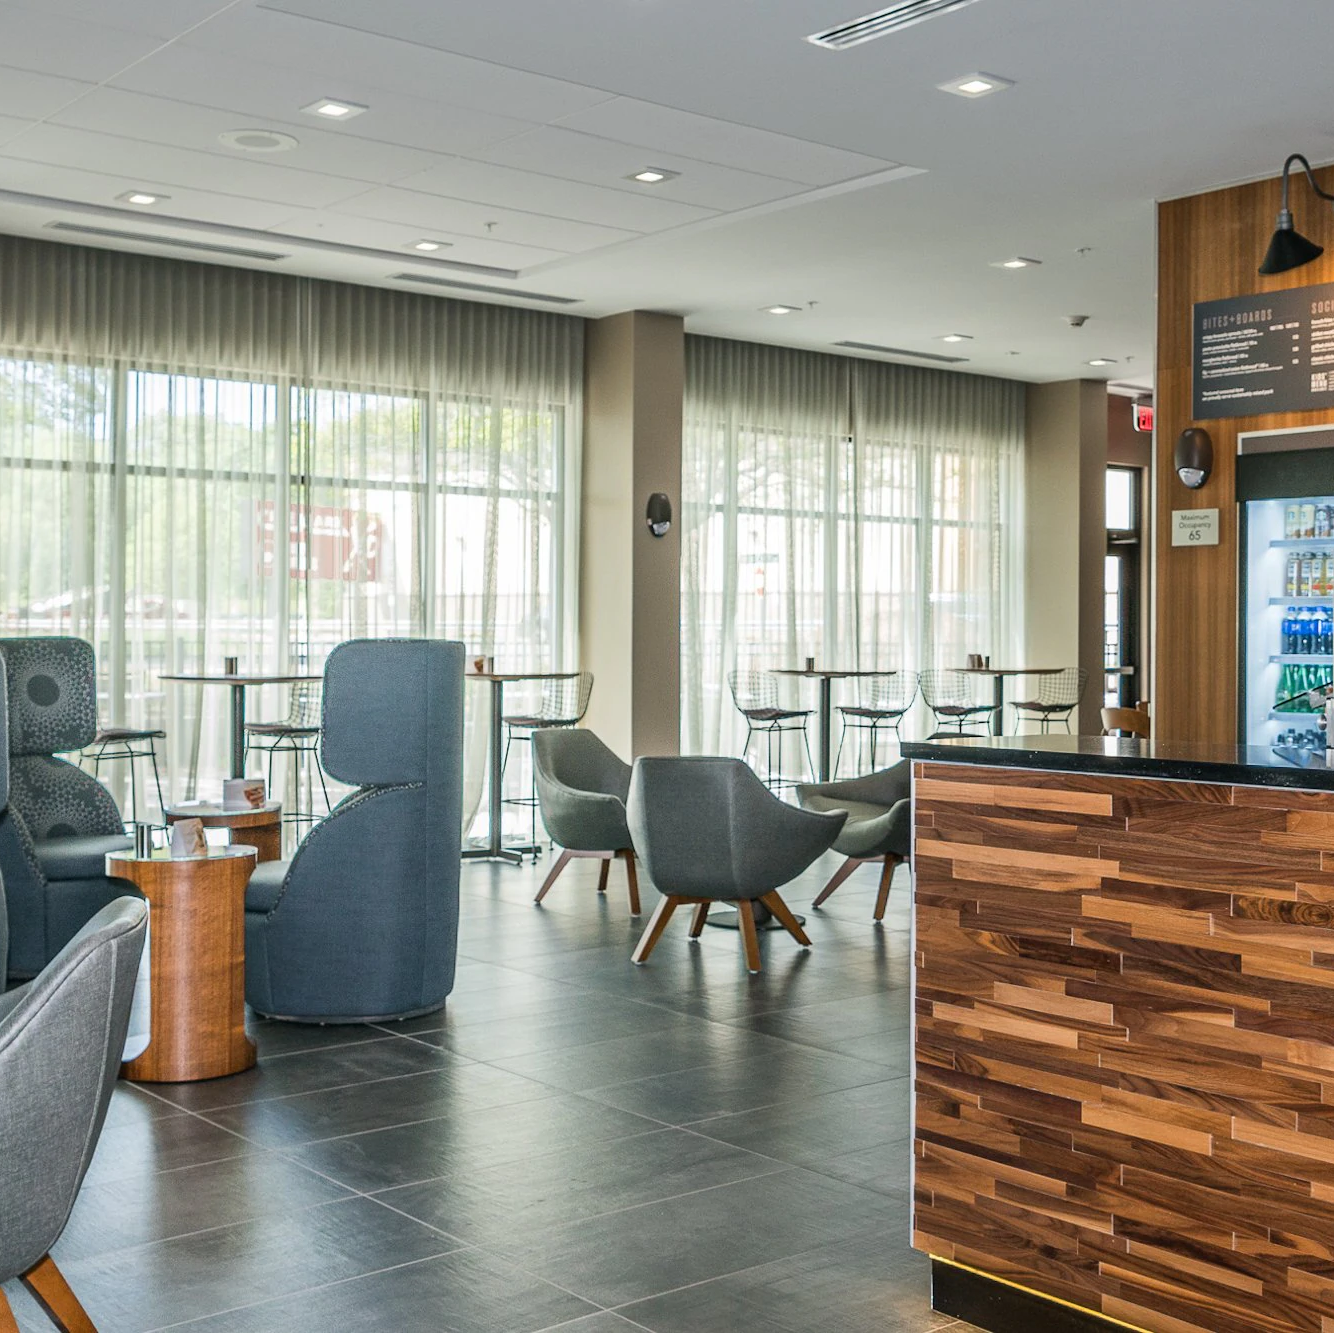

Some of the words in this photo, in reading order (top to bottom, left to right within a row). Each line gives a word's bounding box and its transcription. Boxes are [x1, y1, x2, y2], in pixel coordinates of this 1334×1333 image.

[1202, 309, 1273, 330] BITES+BOARDS
[1178, 521, 1211, 529] Occupancy
[1188, 531, 1201, 541] 65
